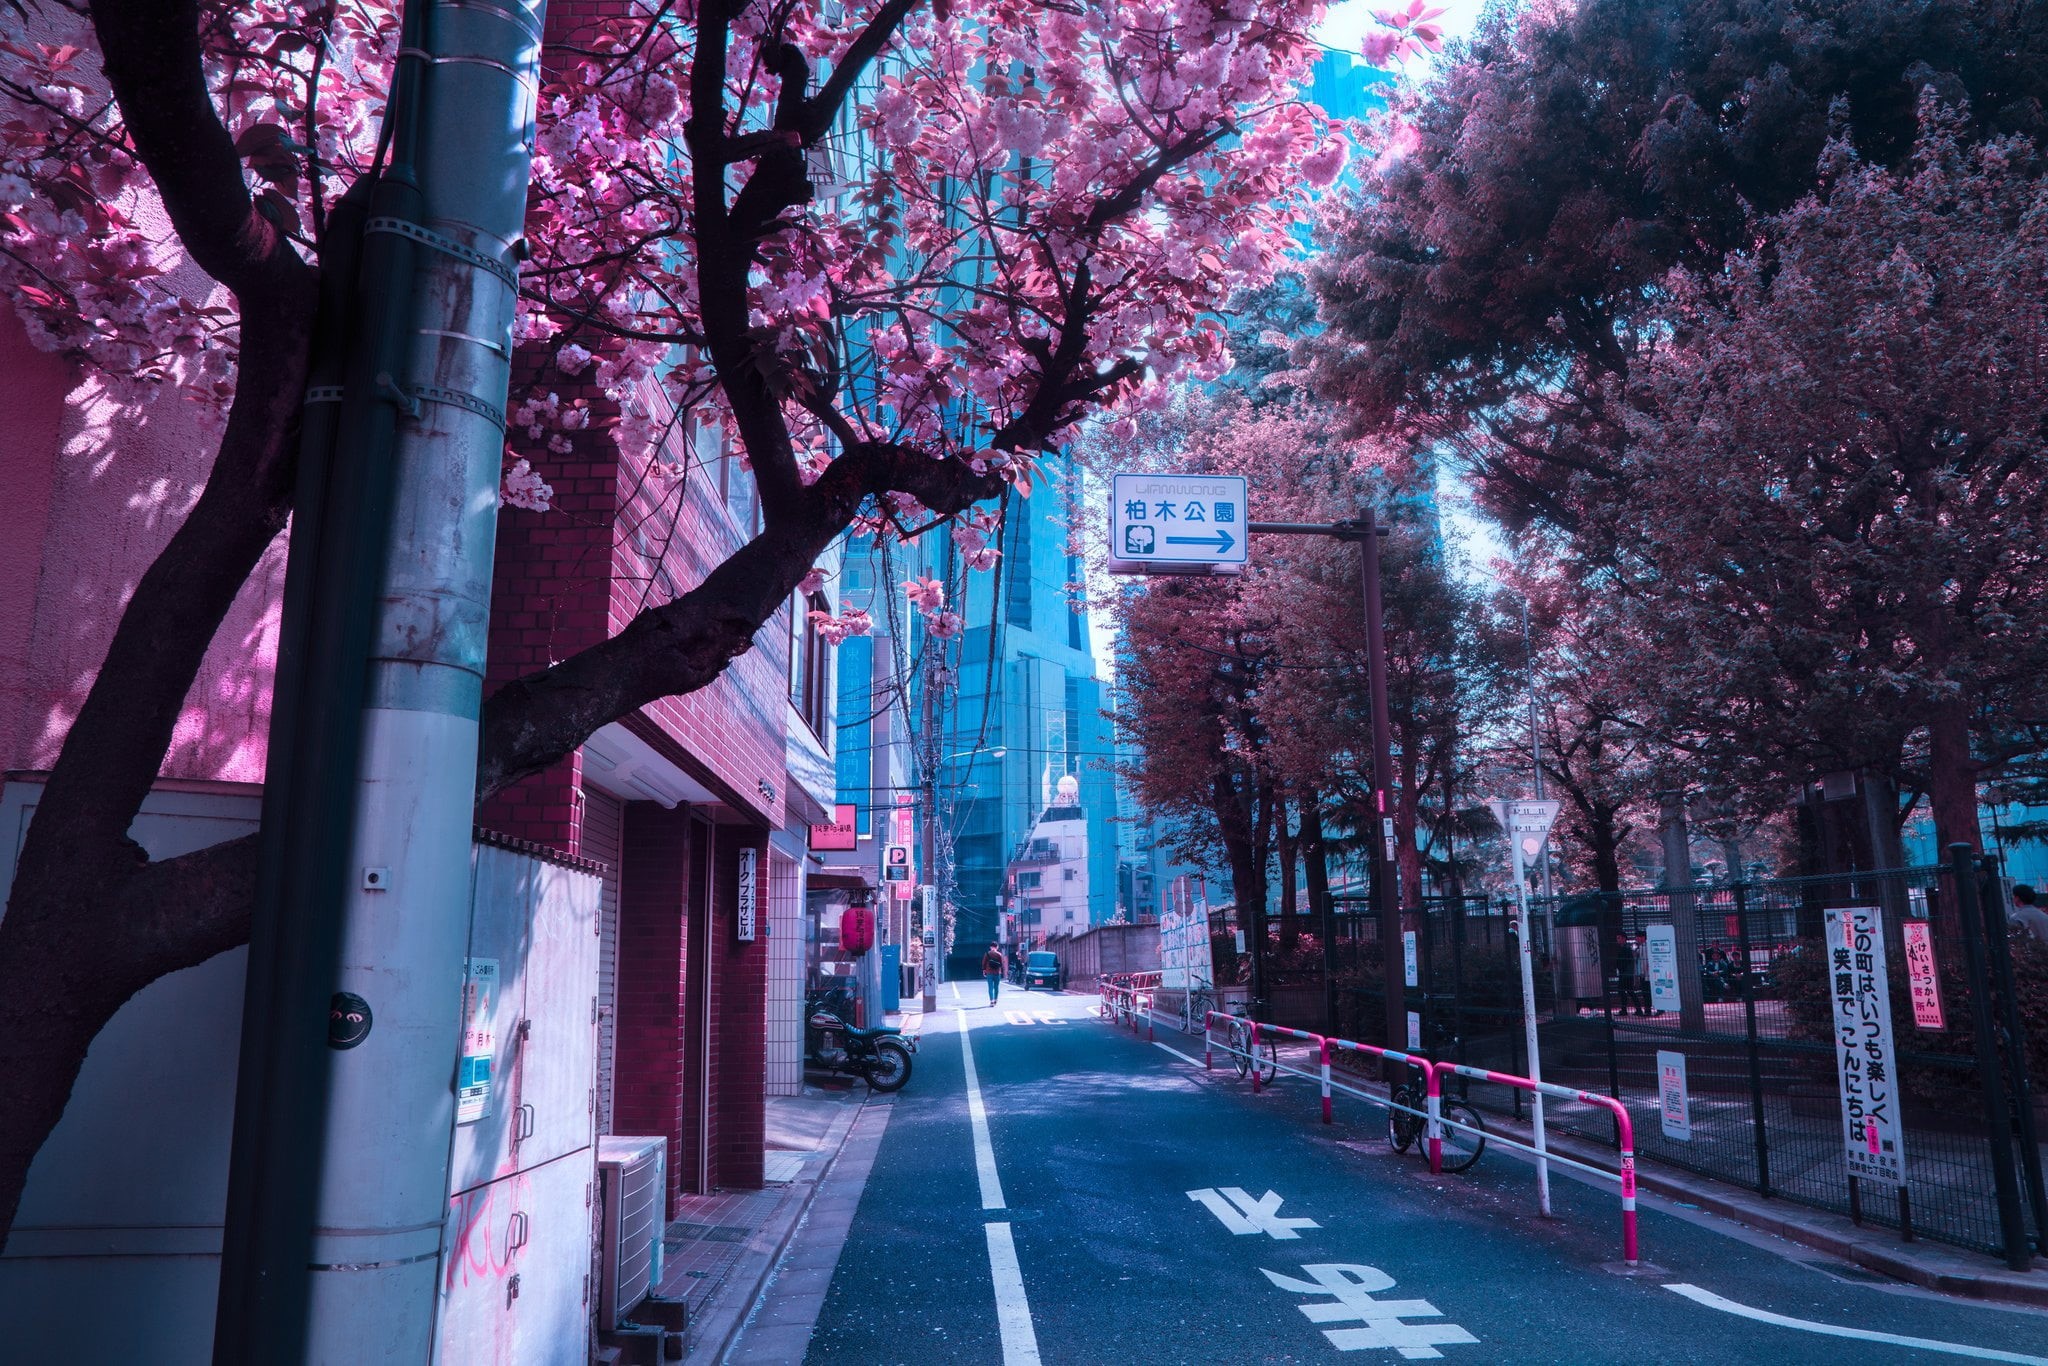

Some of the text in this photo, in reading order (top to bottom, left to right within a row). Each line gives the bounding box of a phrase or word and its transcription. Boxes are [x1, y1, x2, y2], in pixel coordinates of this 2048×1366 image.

[1125, 499, 1235, 522] 柏木公園
[892, 849, 905, 863] P
[739, 850, 750, 937] オークプラザビル
[1917, 943, 1936, 1008] けいさつかん
[1854, 915, 1889, 1125] この町は、いつも楽しく
